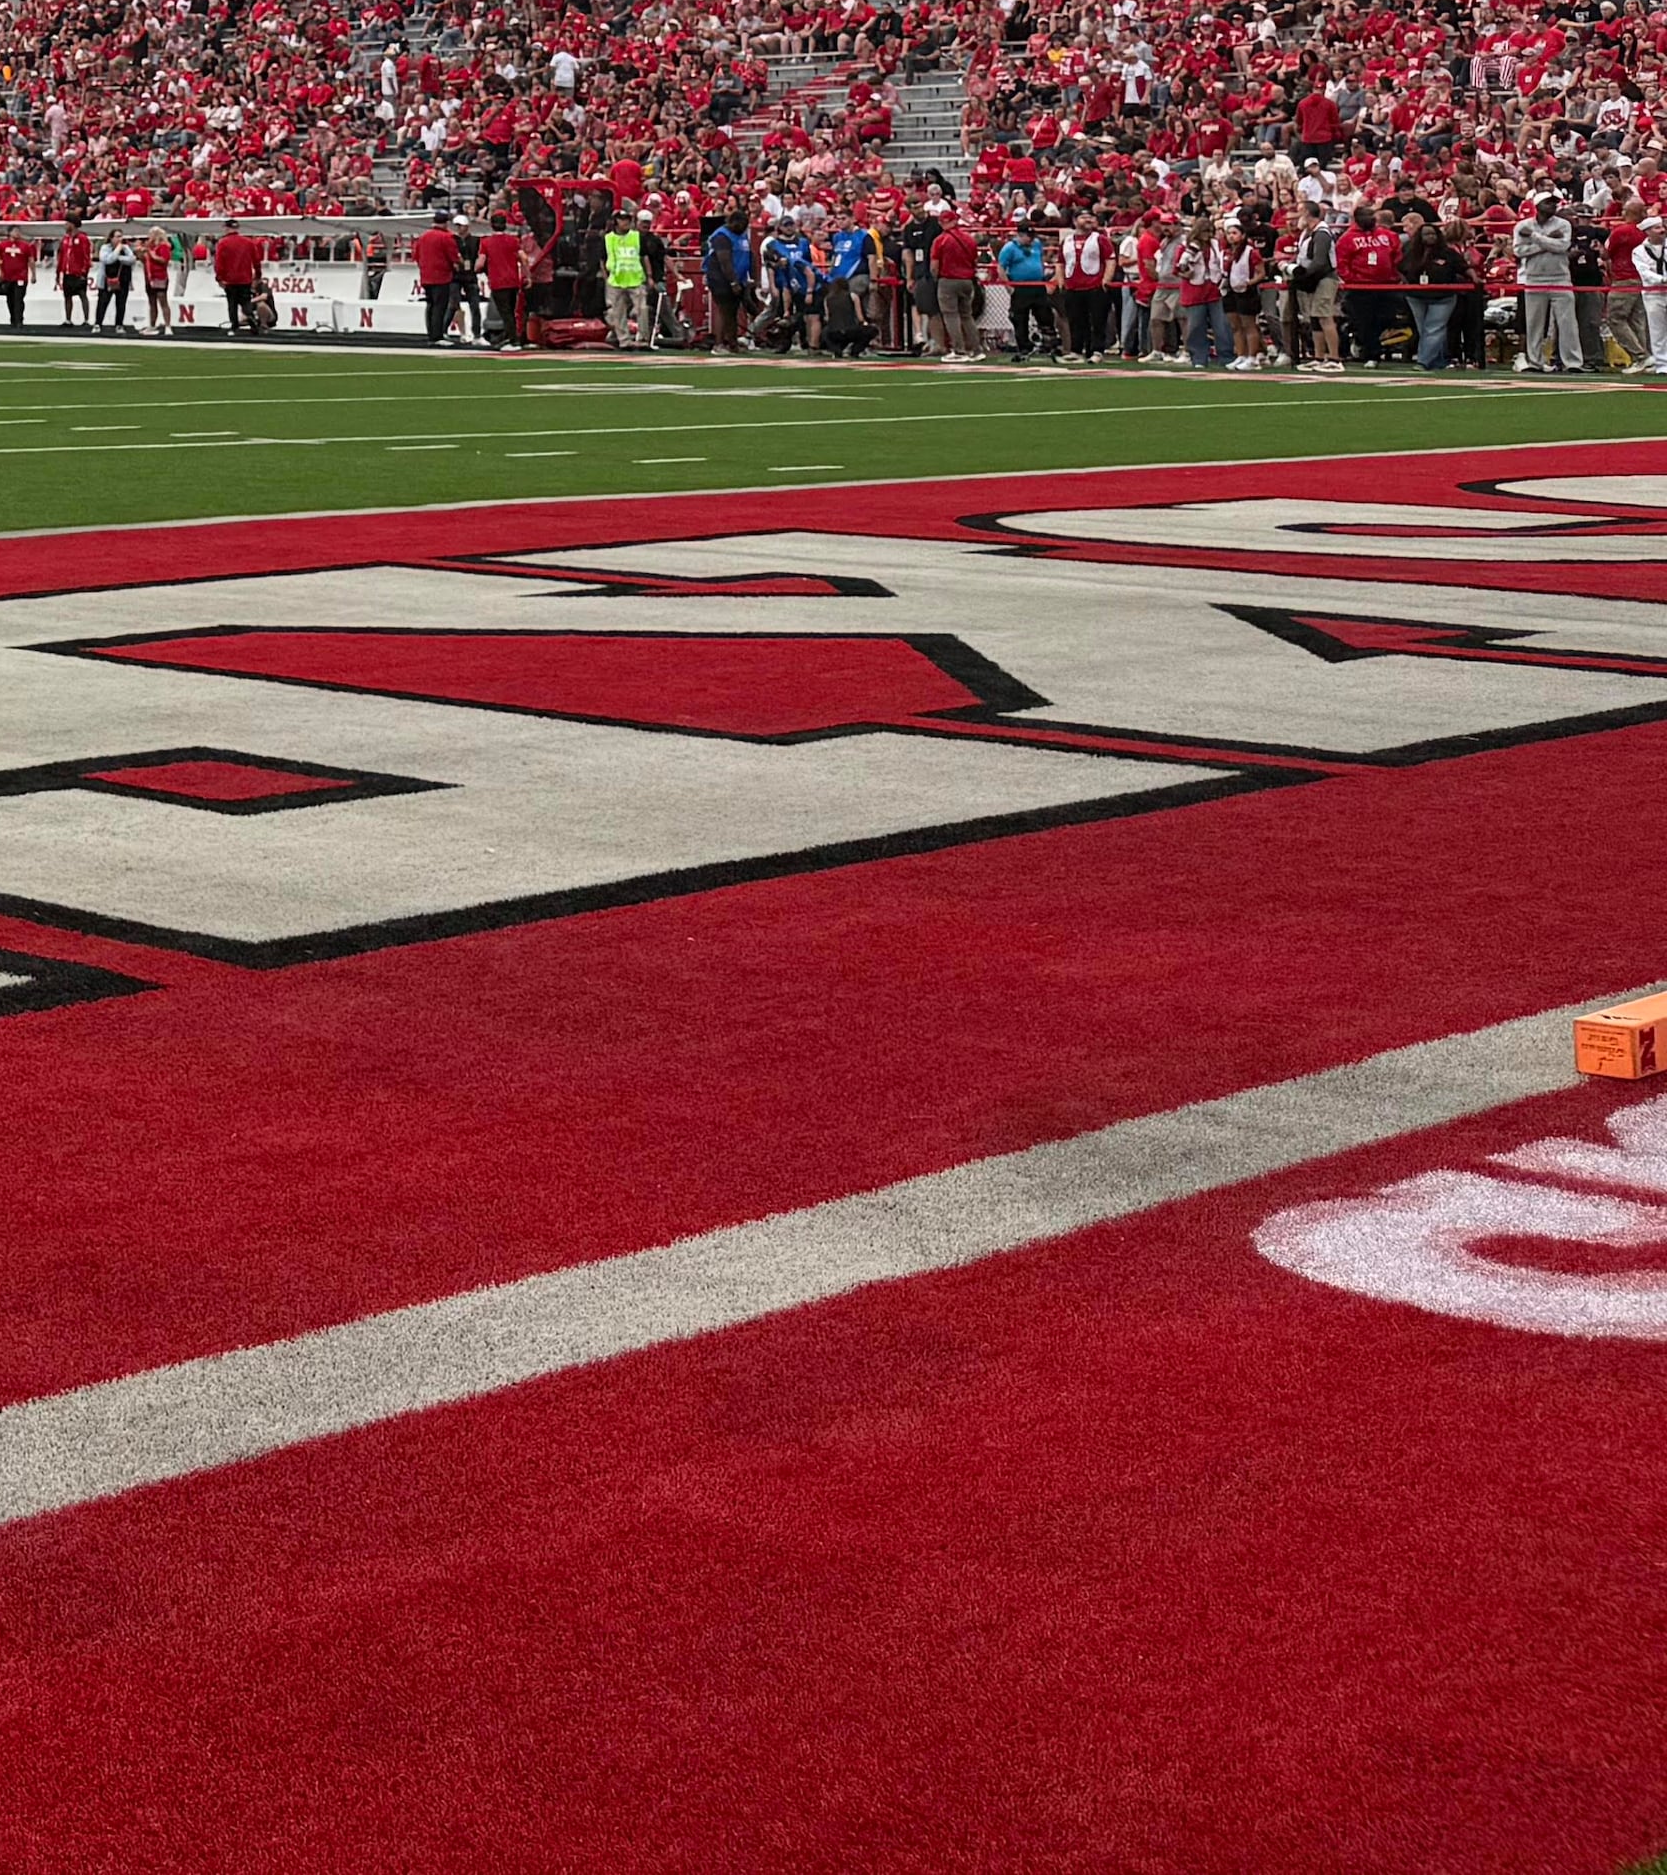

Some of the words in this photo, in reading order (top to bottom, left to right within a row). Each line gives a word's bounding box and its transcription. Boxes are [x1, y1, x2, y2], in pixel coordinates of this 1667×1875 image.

[179, 304, 194, 323] N
[291, 307, 308, 326] N
[360, 308, 373, 327] N
